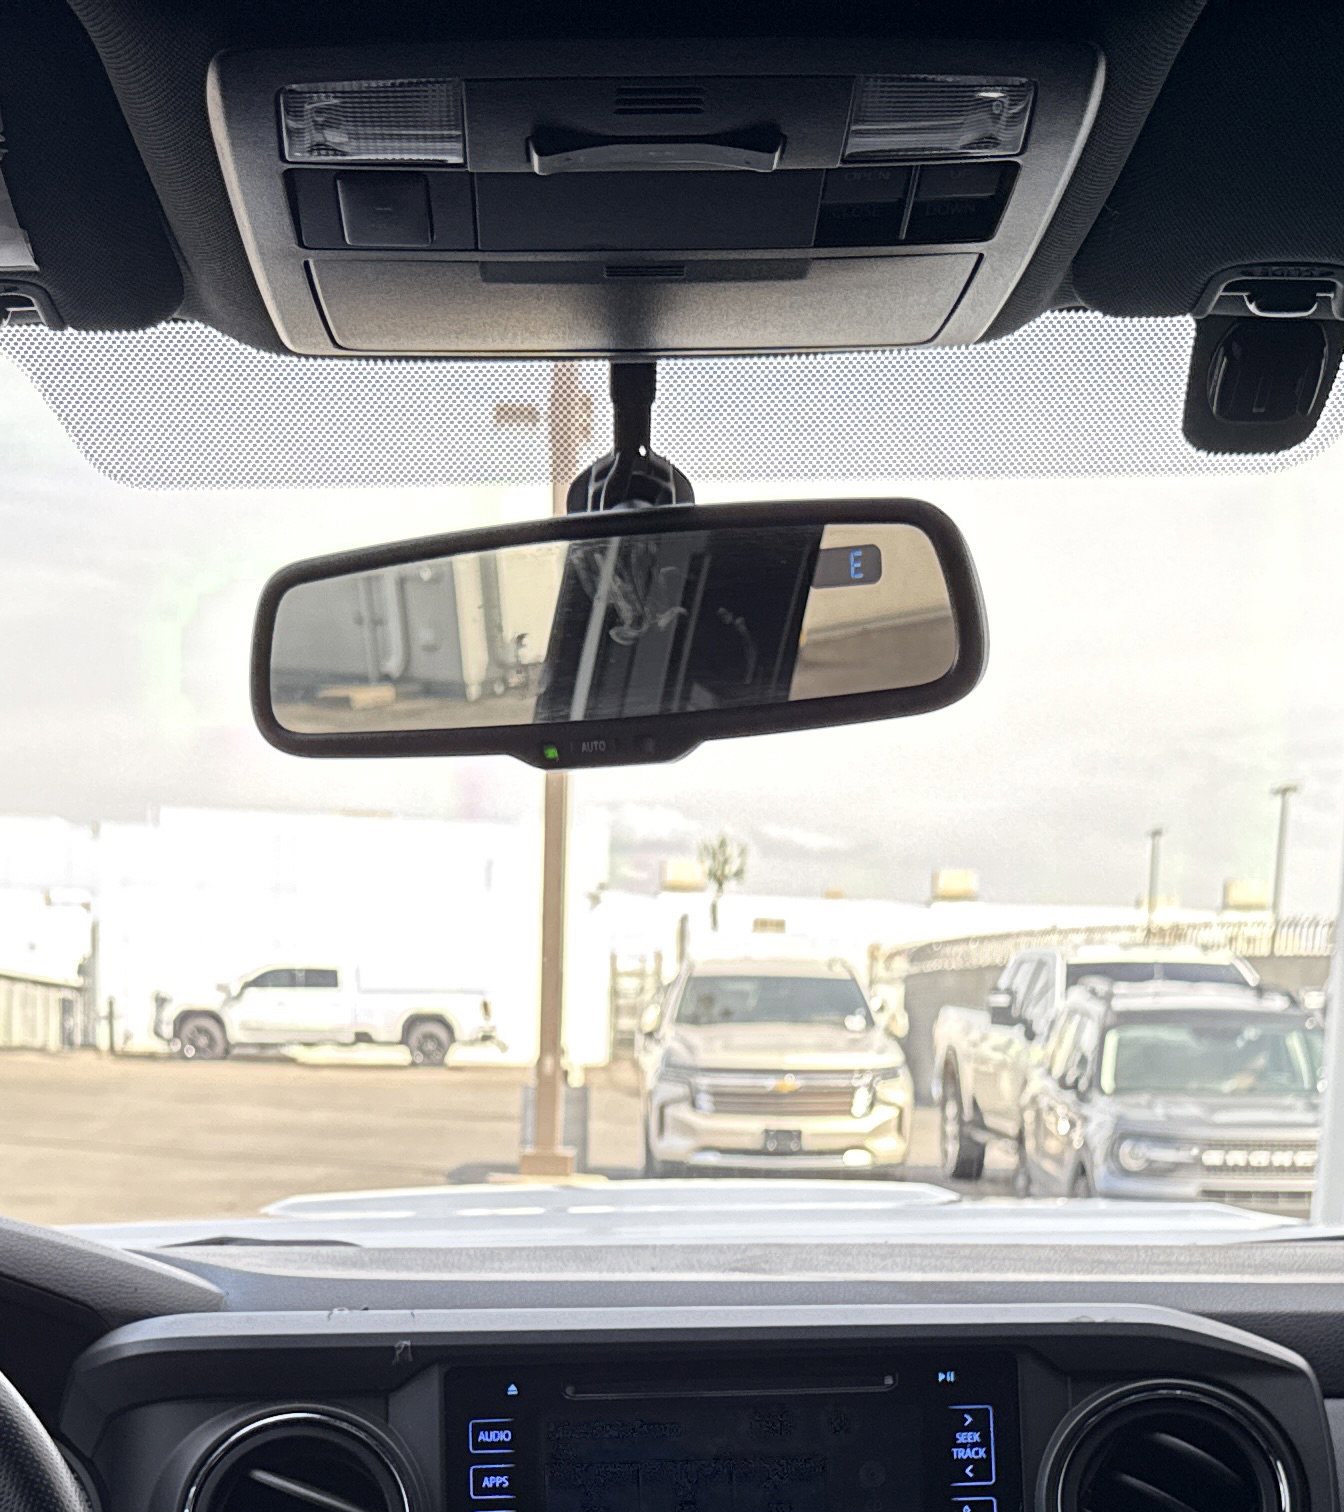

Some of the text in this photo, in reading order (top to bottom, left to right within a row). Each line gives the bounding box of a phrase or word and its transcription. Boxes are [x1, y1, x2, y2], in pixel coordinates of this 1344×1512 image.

[581, 740, 607, 753] AUTO
[477, 1429, 513, 1443] AUDIO
[955, 1431, 981, 1444] SEEK
[950, 1445, 987, 1460] TRACK
[481, 1475, 510, 1489] APPS
